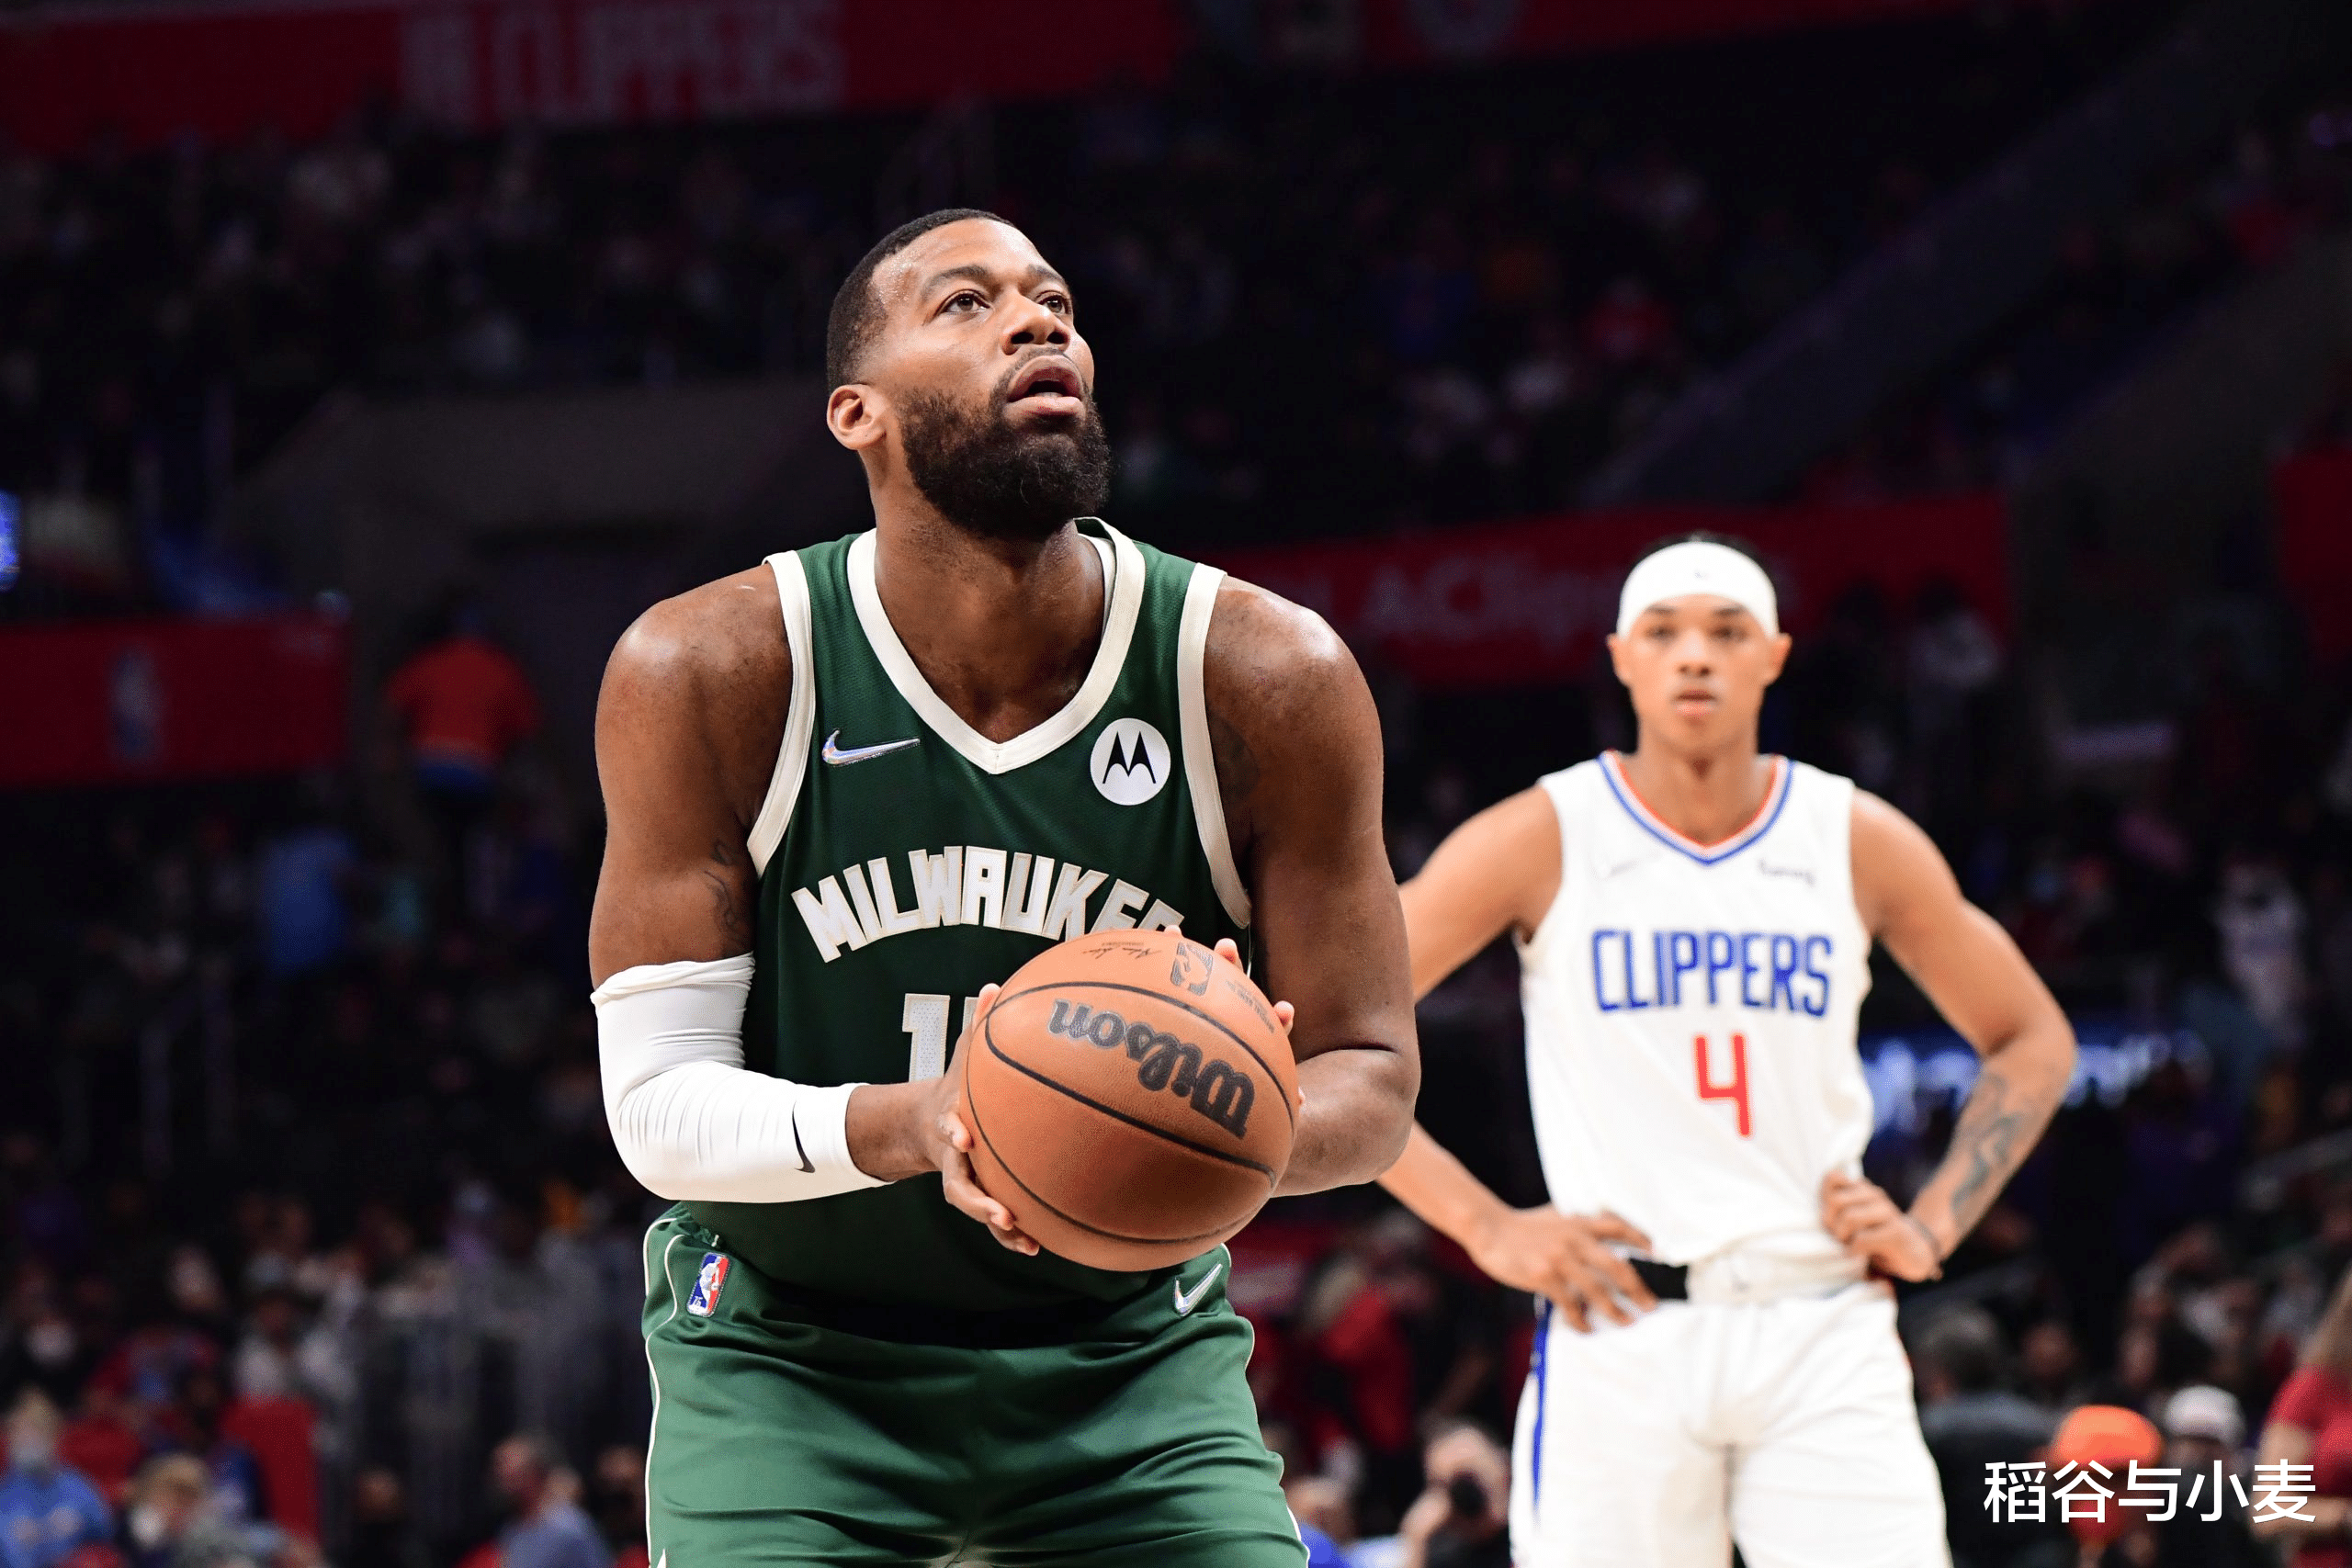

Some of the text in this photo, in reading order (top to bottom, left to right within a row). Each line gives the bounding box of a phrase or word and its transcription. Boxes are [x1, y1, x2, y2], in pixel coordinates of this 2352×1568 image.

[1592, 929, 1833, 1019] CLIPPERS
[902, 993, 980, 1082] 1
[1048, 998, 1255, 1140] Wilson
[1694, 1032, 1754, 1140] 4
